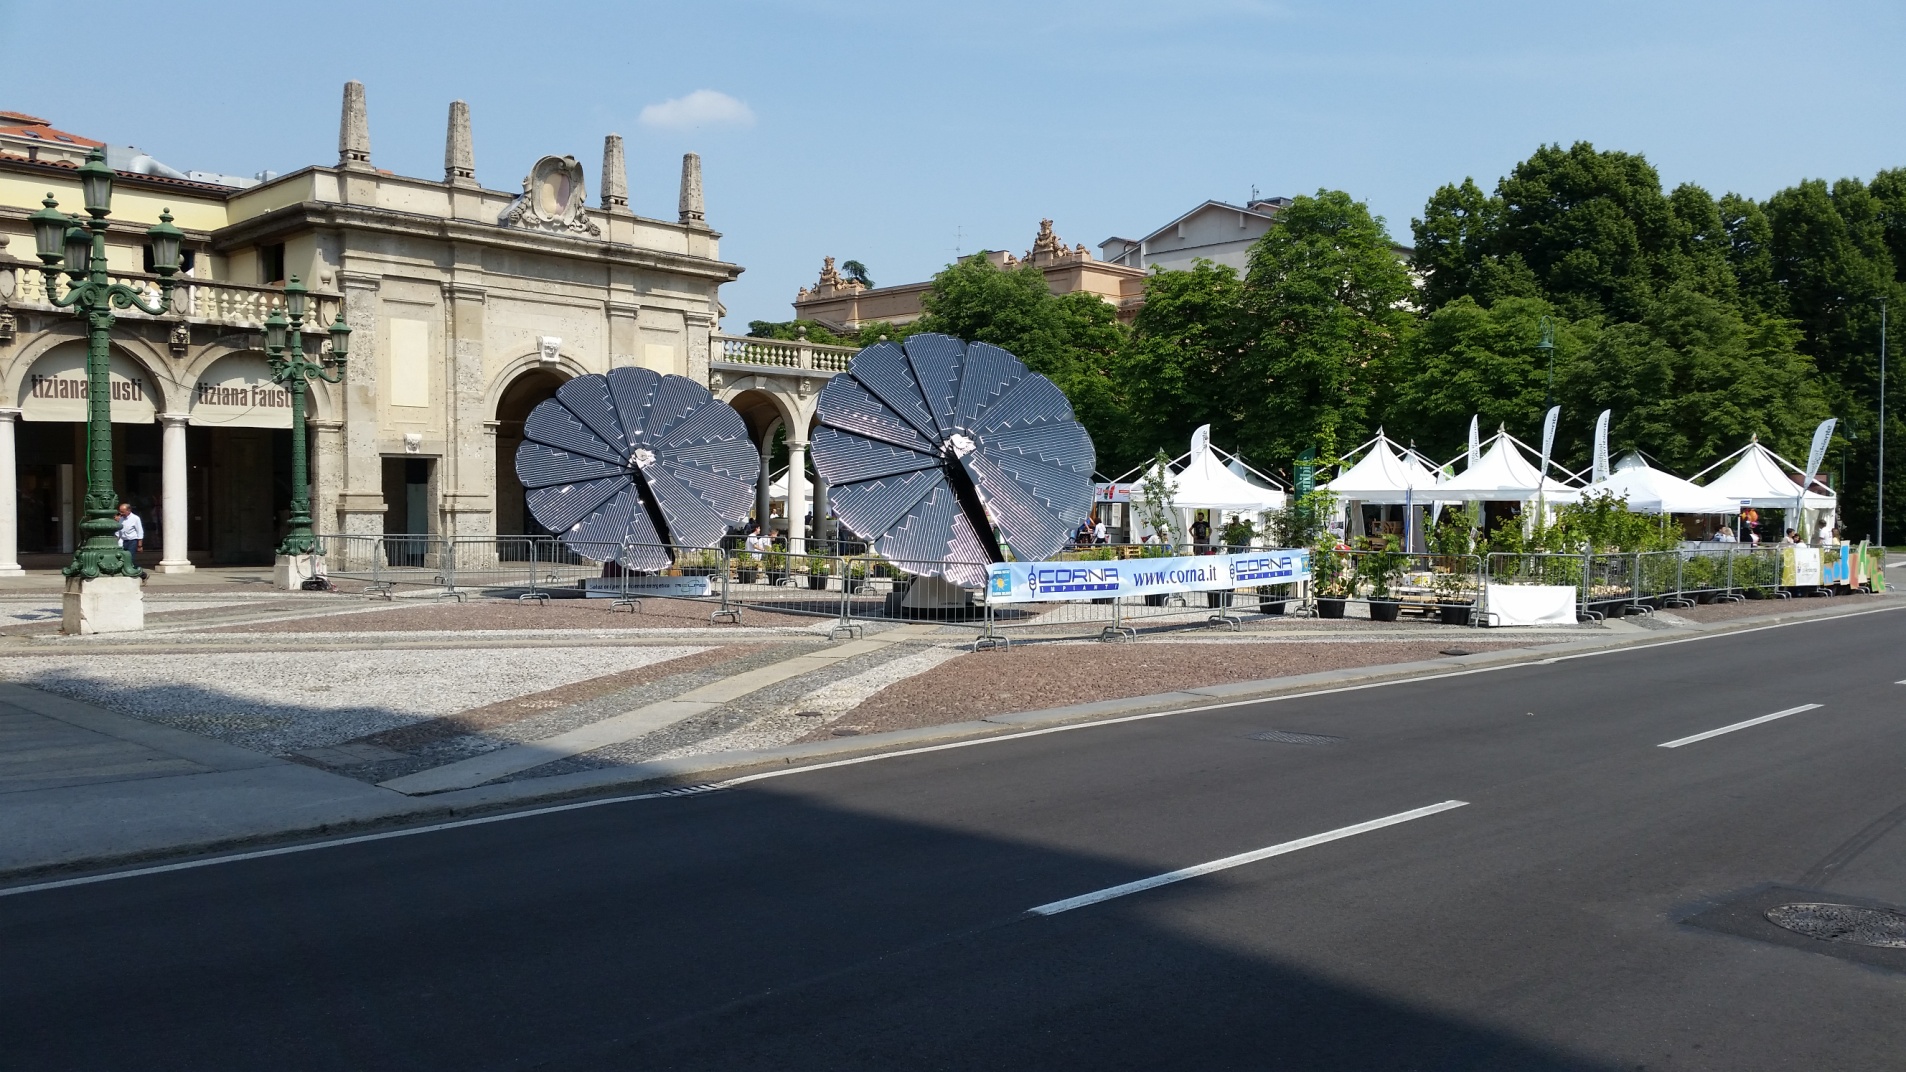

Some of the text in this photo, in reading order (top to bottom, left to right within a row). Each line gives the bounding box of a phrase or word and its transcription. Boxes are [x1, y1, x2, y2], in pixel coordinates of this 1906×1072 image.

[31, 374, 142, 402] tiziana usti
[197, 382, 248, 407] tiziana
[1236, 557, 1293, 573] CORNA
[1039, 567, 1119, 584] CORNA
[1133, 564, 1217, 587] www.corna.it
[1040, 584, 1119, 593] IMPIANTI
